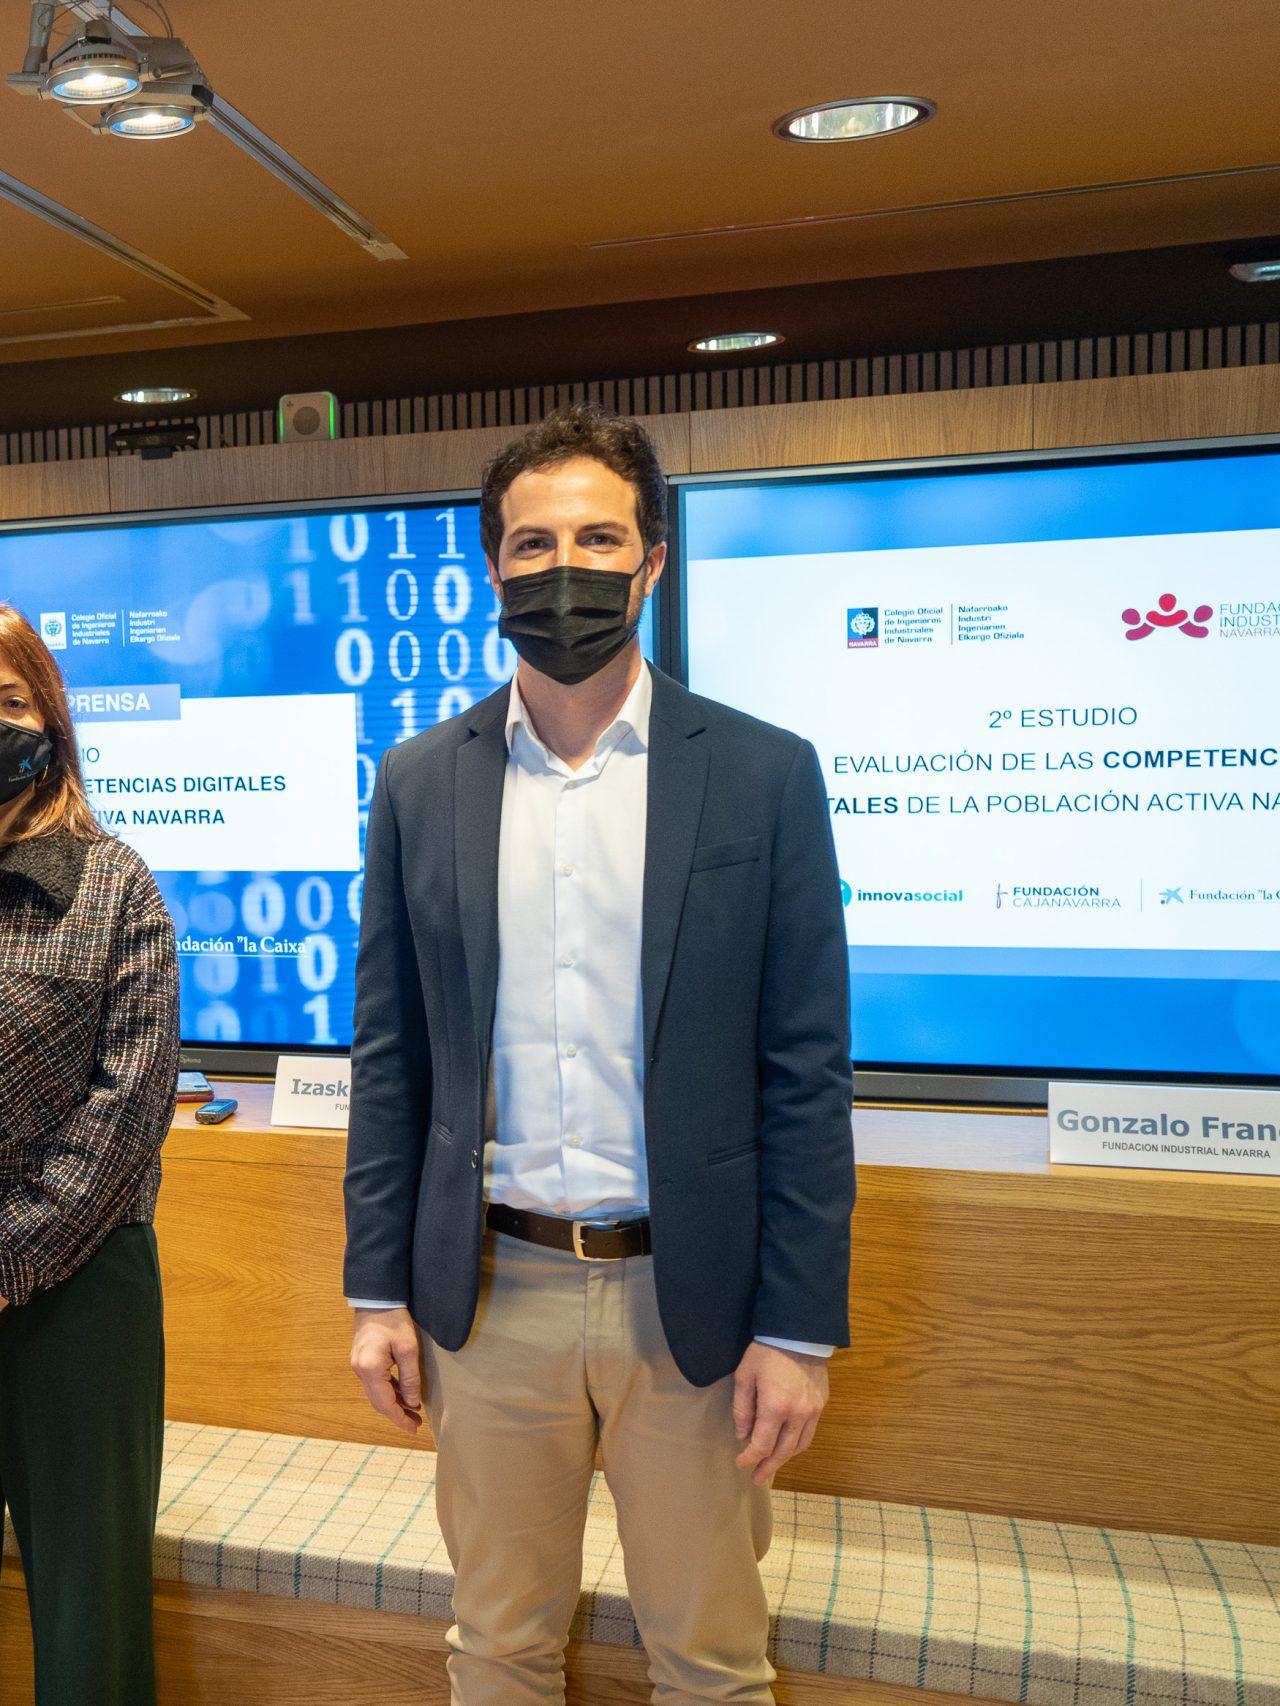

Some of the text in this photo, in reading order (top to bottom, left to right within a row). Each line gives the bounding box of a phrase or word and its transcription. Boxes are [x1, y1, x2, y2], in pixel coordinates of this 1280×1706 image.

[884, 606, 944, 617] Colegio Oficial
[958, 605, 1009, 614] Nafarroako
[71, 611, 117, 624] Colegio Oficial
[129, 619, 155, 628] Industri
[884, 617, 942, 627] de Ingenieros
[958, 615, 992, 623] Industri
[71, 622, 80, 630] de
[884, 626, 934, 635] Industriales
[1220, 626, 1280, 639] NAVARRA
[72, 638, 81, 646] de
[82, 637, 110, 646] Navarra
[848, 640, 878, 648] NAVARRA
[884, 635, 933, 644] de Navarra
[989, 707, 1138, 729] 2º ESTUDIO
[834, 750, 993, 774] EVALUACIÓN
[1002, 753, 1036, 771] DE
[1045, 751, 1094, 770] LAS
[183, 775, 286, 793] DIGITALES
[908, 797, 941, 814] DE
[950, 796, 980, 813] LA
[987, 789, 1139, 814] POBLACIÓN
[1147, 793, 1245, 812] ACTIVA
[132, 808, 225, 825] NAVARRA
[858, 889, 963, 902] innovasocial
[1013, 884, 1099, 896] FUNDACIÓN
[1190, 888, 1256, 901] Fundación
[1012, 898, 1122, 909] CAJANAVARRA
[1057, 1109, 1190, 1138] Gonzalo
[1102, 1141, 1271, 1159] FUNDACION INDUSTRIAL NAVARRA
